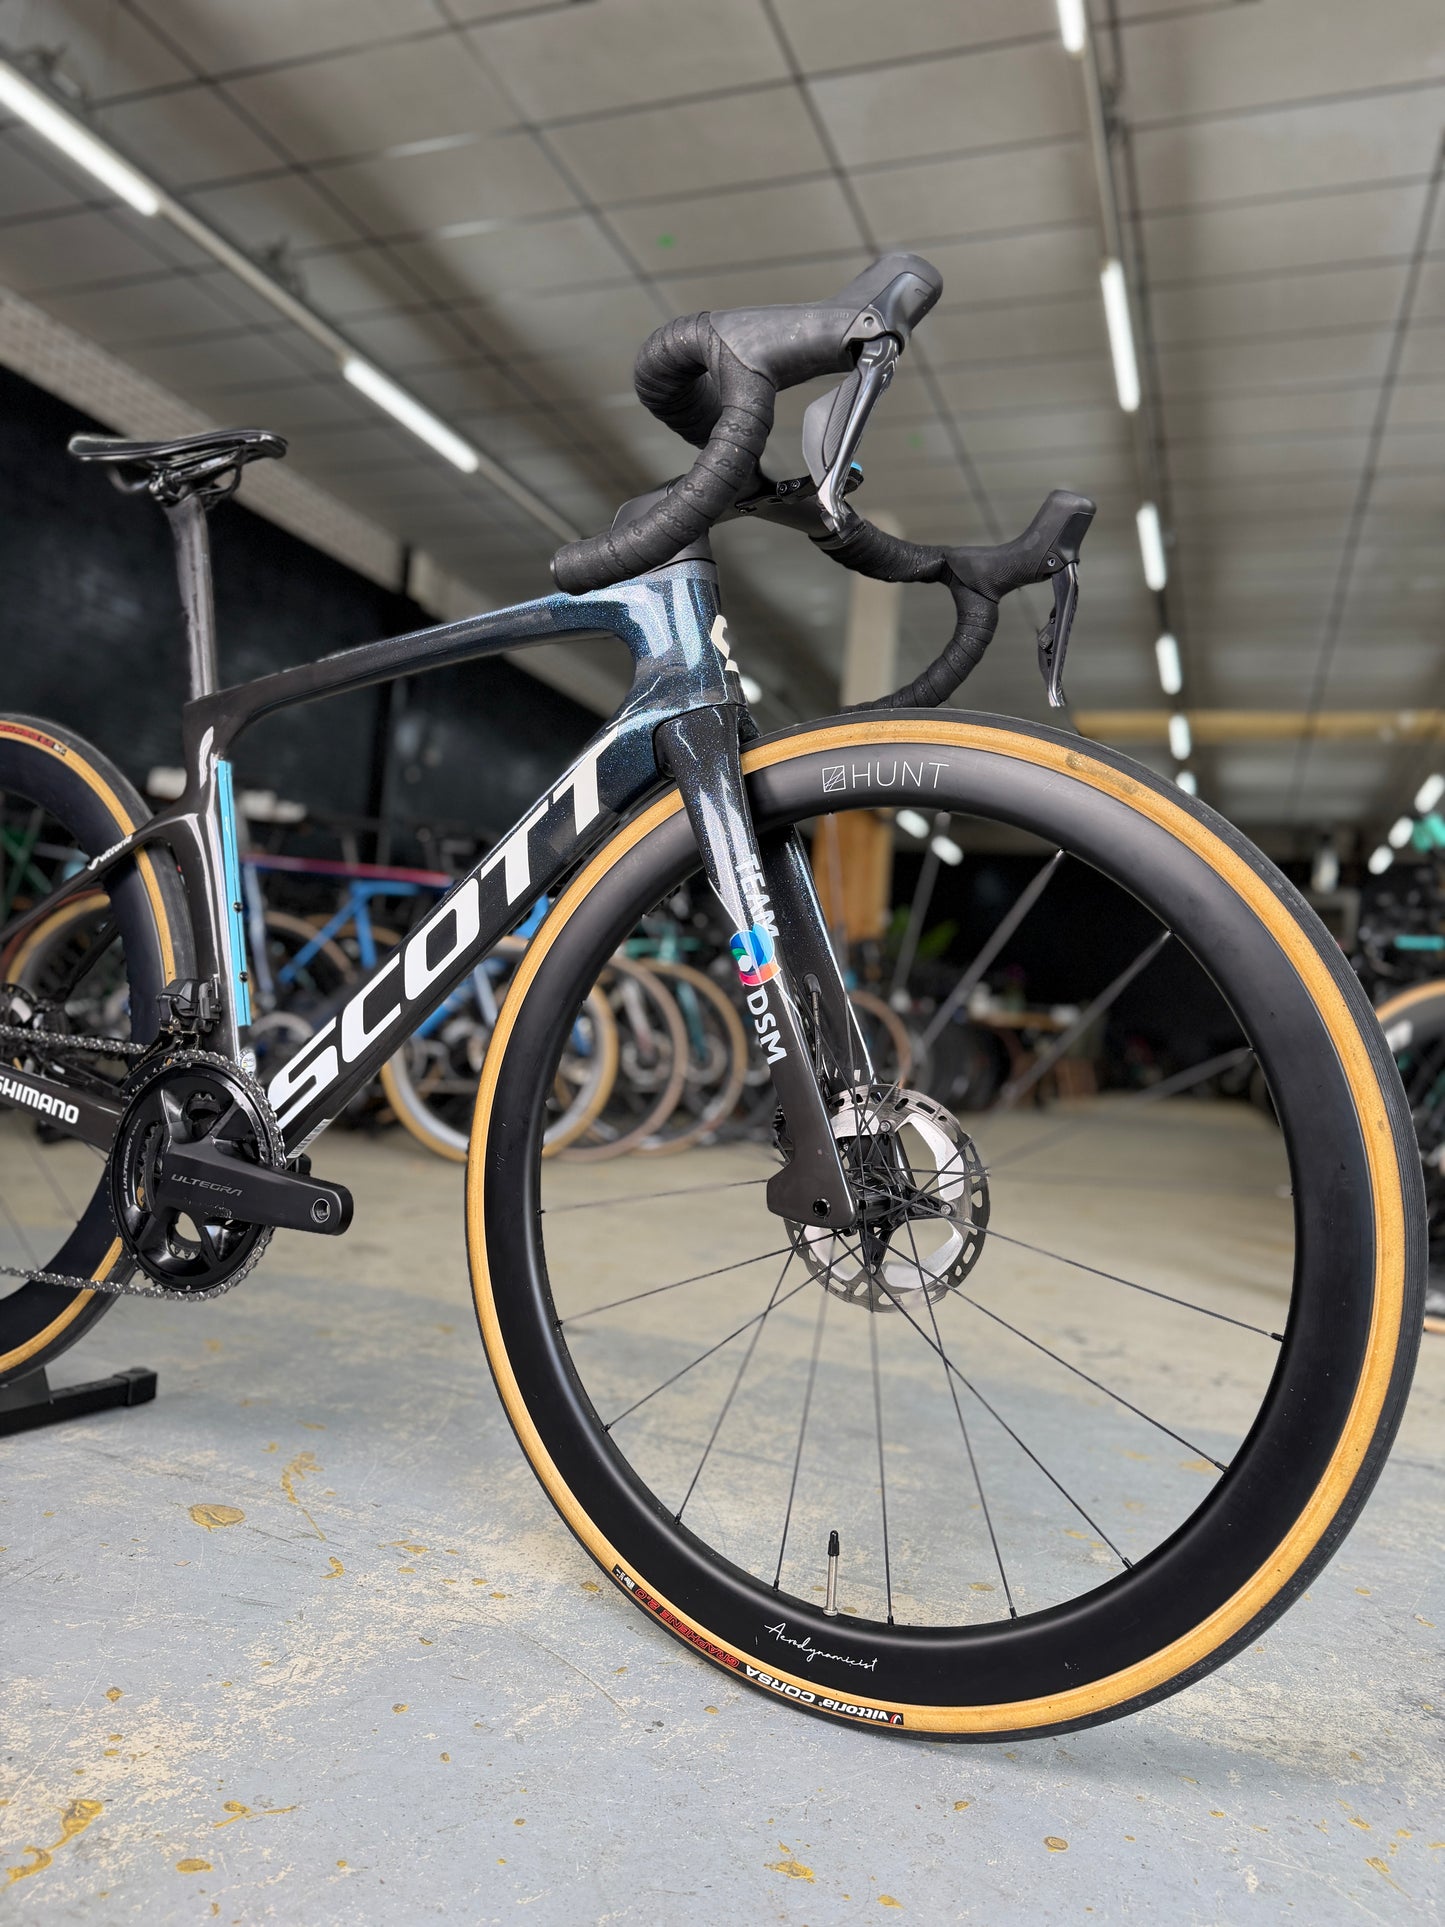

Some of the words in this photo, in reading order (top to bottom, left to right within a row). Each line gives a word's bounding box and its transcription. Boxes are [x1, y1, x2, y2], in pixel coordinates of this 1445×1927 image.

[852, 760, 950, 789] HUNT
[735, 853, 780, 937] TEAM
[267, 726, 619, 1129] SCOTT
[746, 986, 788, 1065] DSM
[171, 1173, 243, 1197] ULTEGRA
[634, 1587, 661, 1612] 2.0
[659, 1609, 740, 1668] GRAPHENE
[763, 1622, 879, 1673] Aerodynamicist
[746, 1664, 816, 1705] CORSA
